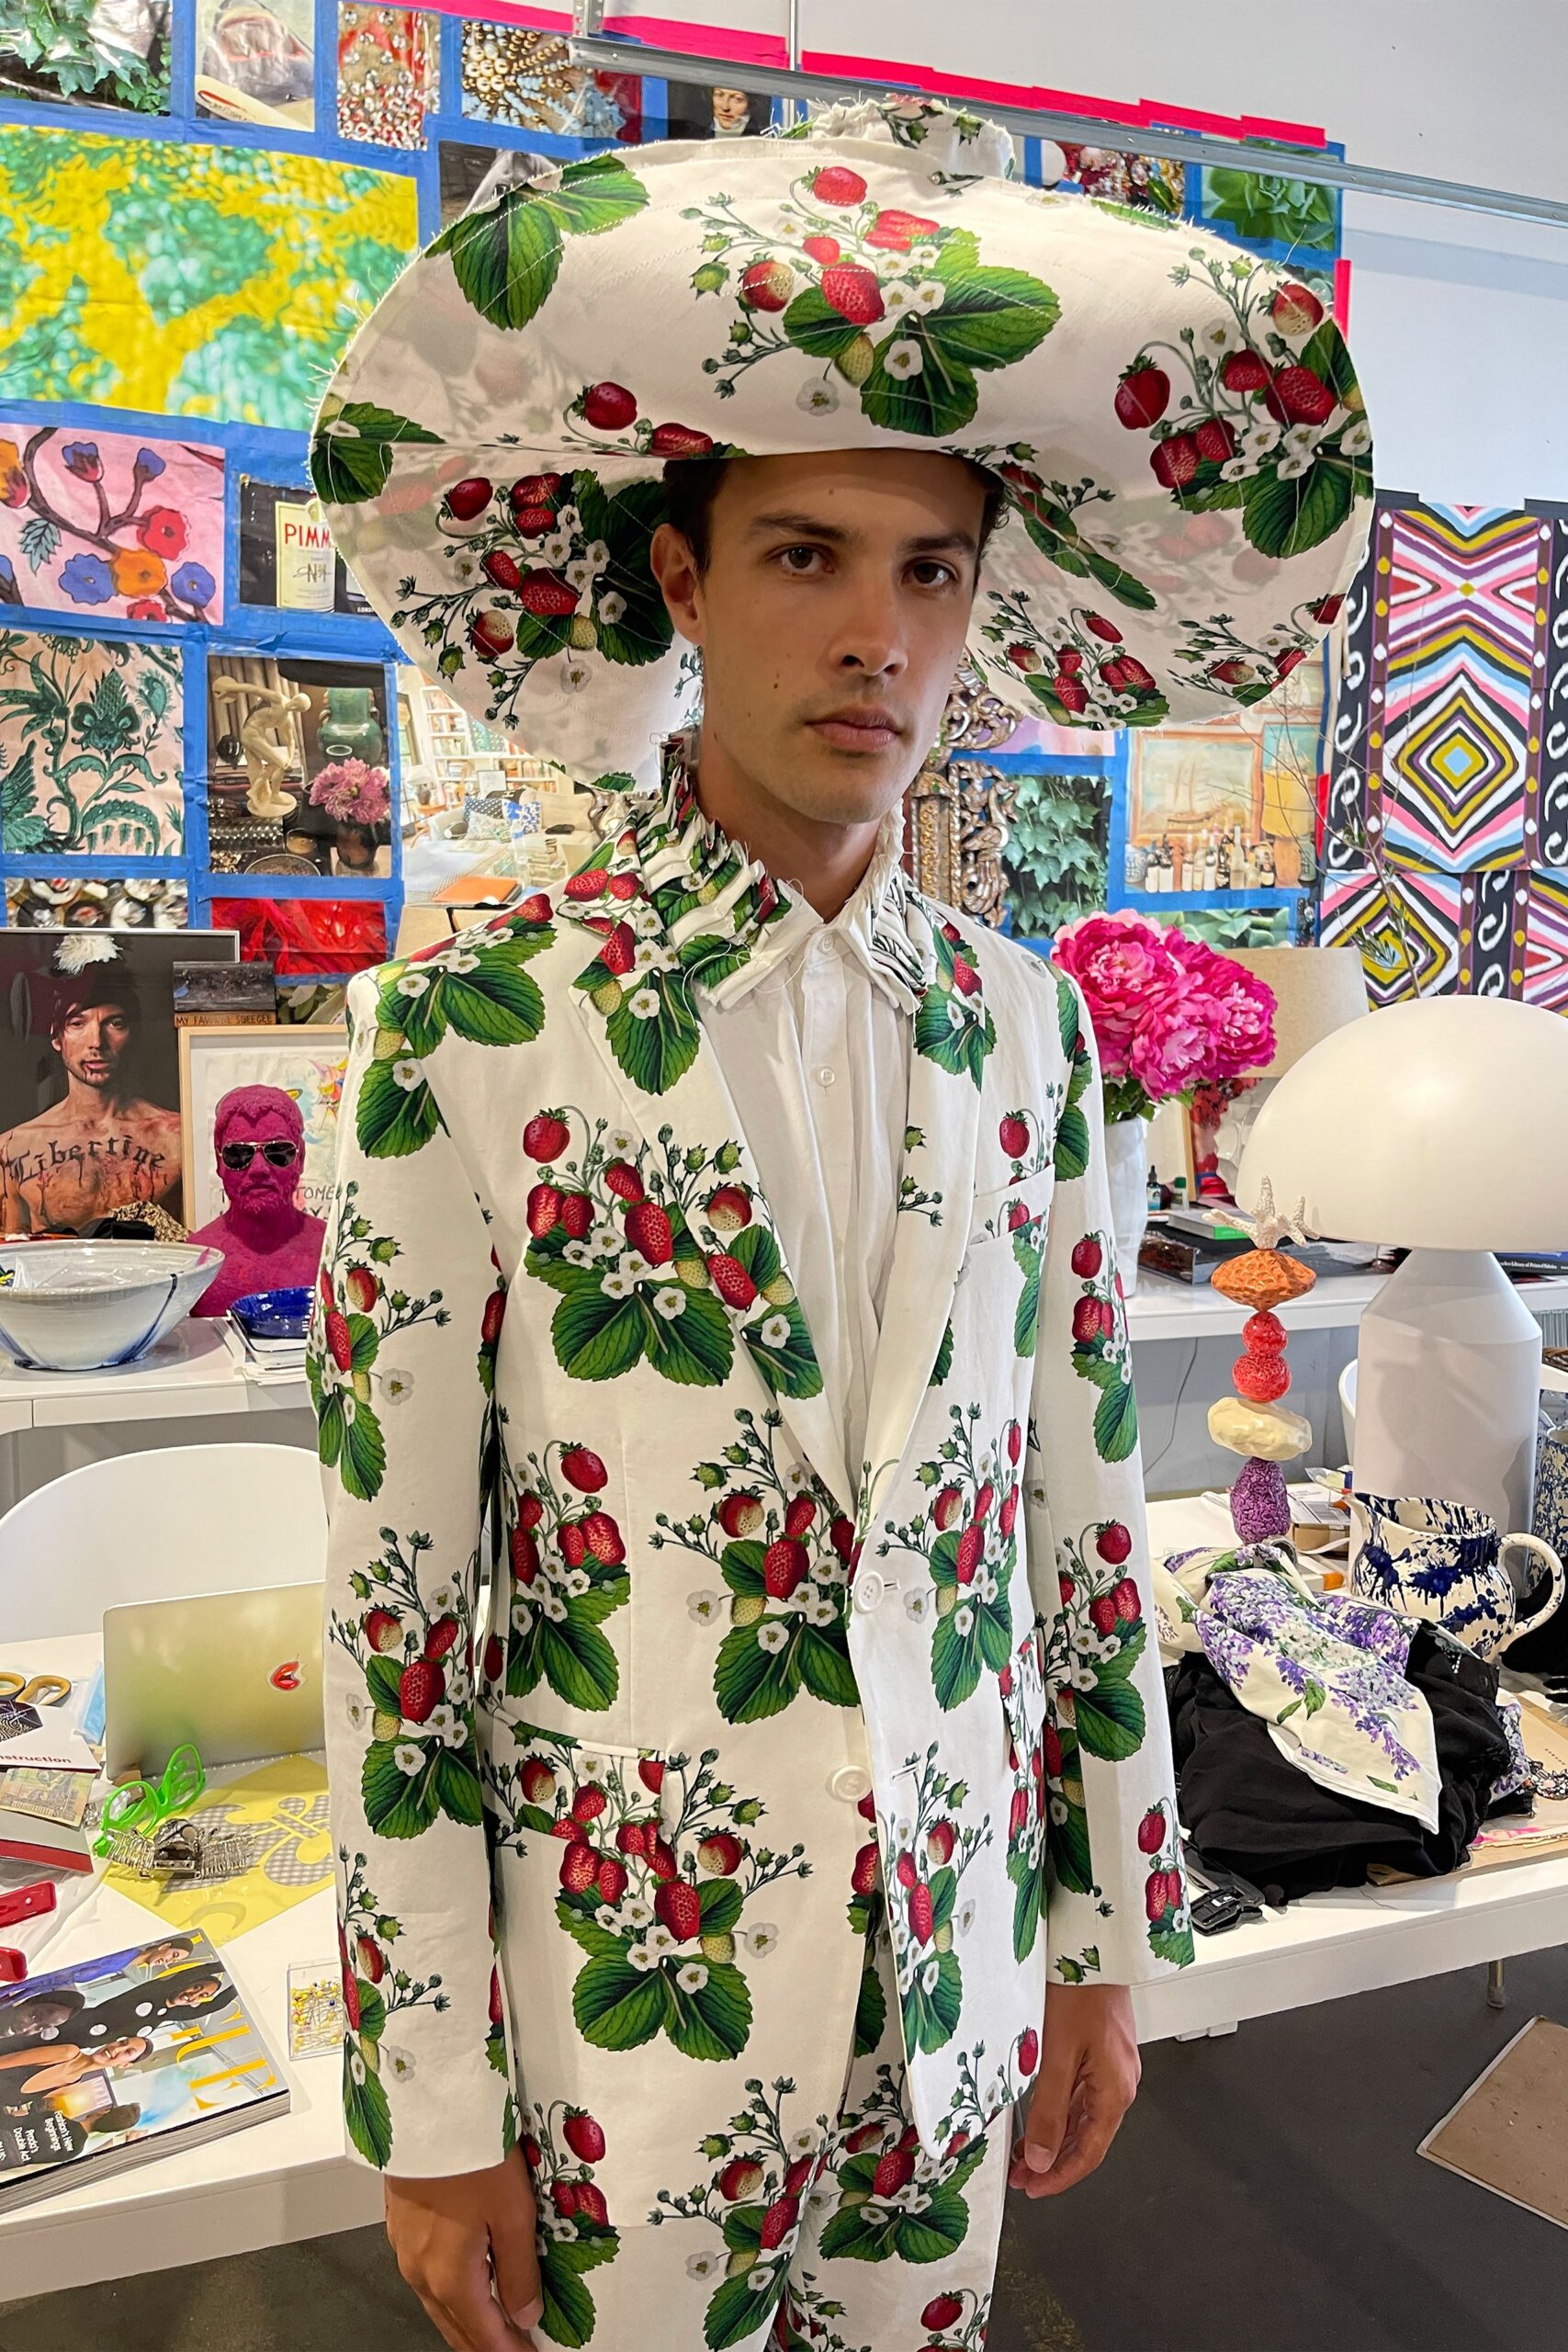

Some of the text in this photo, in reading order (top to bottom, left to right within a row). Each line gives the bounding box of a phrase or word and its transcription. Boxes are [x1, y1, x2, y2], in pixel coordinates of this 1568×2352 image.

[175, 1016, 189, 1026] MY
[6, 1135, 165, 1183] Libertine
[14, 2127, 31, 2162] Double Act
[25, 2129, 39, 2154] Prada's
[44, 2117, 62, 2152] Beginnings
[62, 2136, 73, 2152] New
